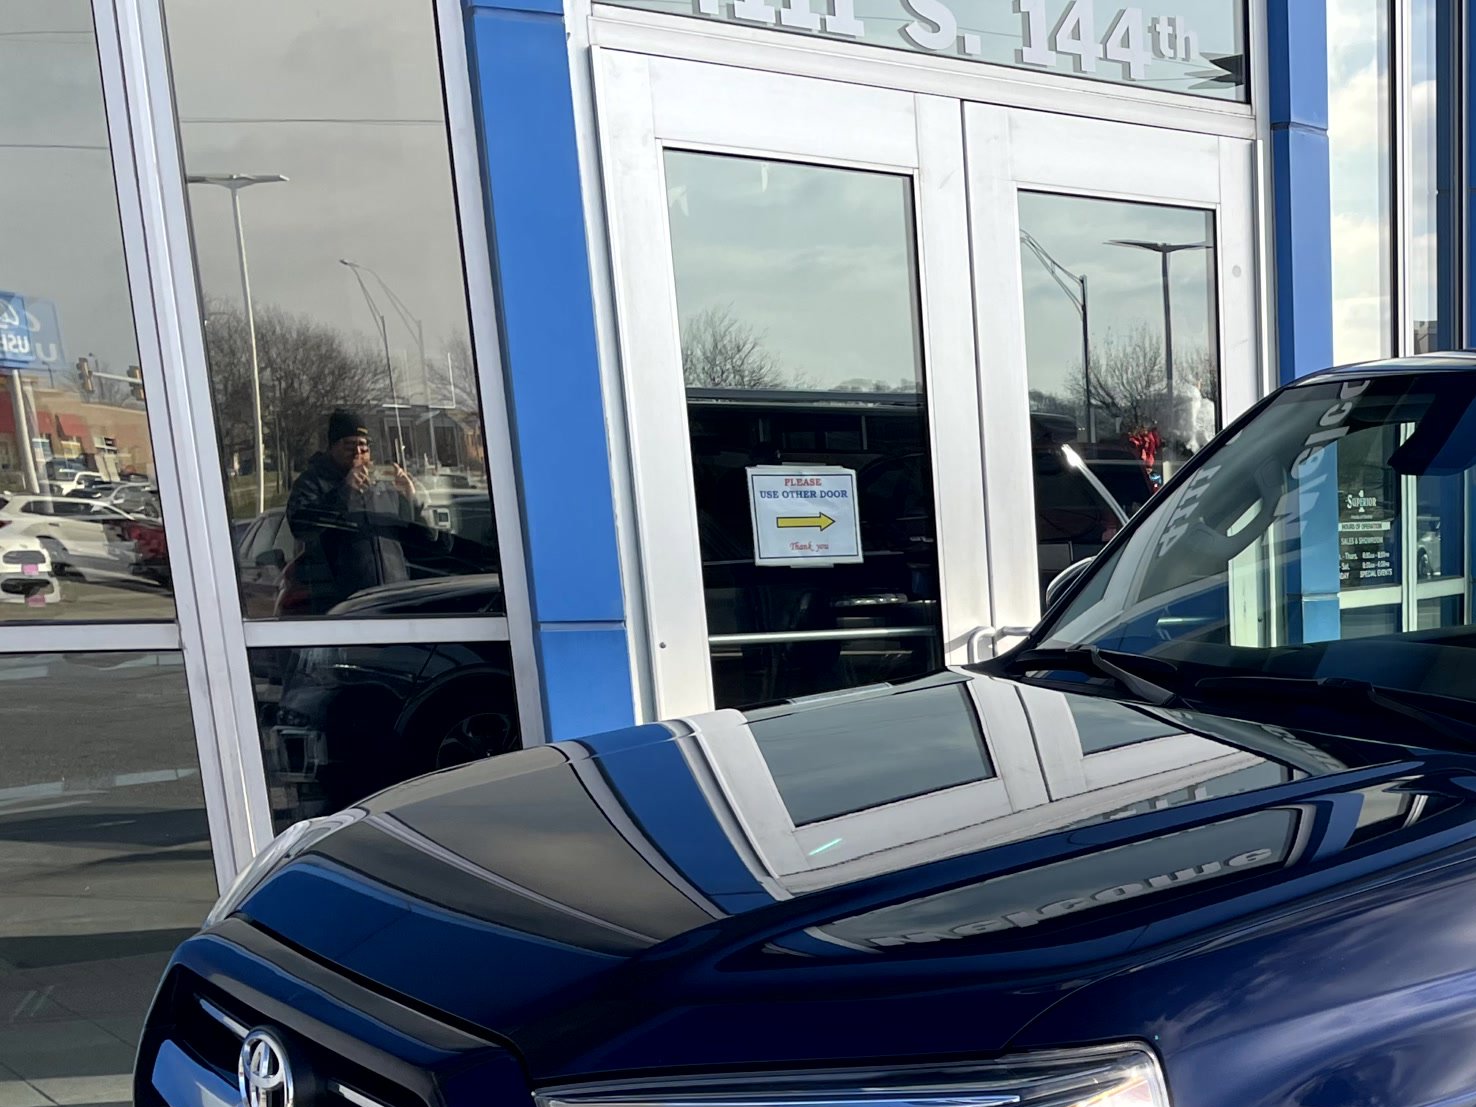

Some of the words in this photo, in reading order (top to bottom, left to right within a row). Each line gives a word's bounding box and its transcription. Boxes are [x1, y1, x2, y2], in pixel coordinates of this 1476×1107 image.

[1015, 0, 1199, 80] 144th
[784, 478, 822, 487] PLEASE
[760, 490, 779, 499] USE
[782, 490, 817, 499] OTHER
[820, 489, 849, 498] DOOR
[1341, 537, 1355, 545] SALES
[1358, 536, 1384, 545] SHOWROOM
[790, 540, 815, 552] Thank
[815, 543, 829, 552] you
[1360, 570, 1376, 578] SPECIAL
